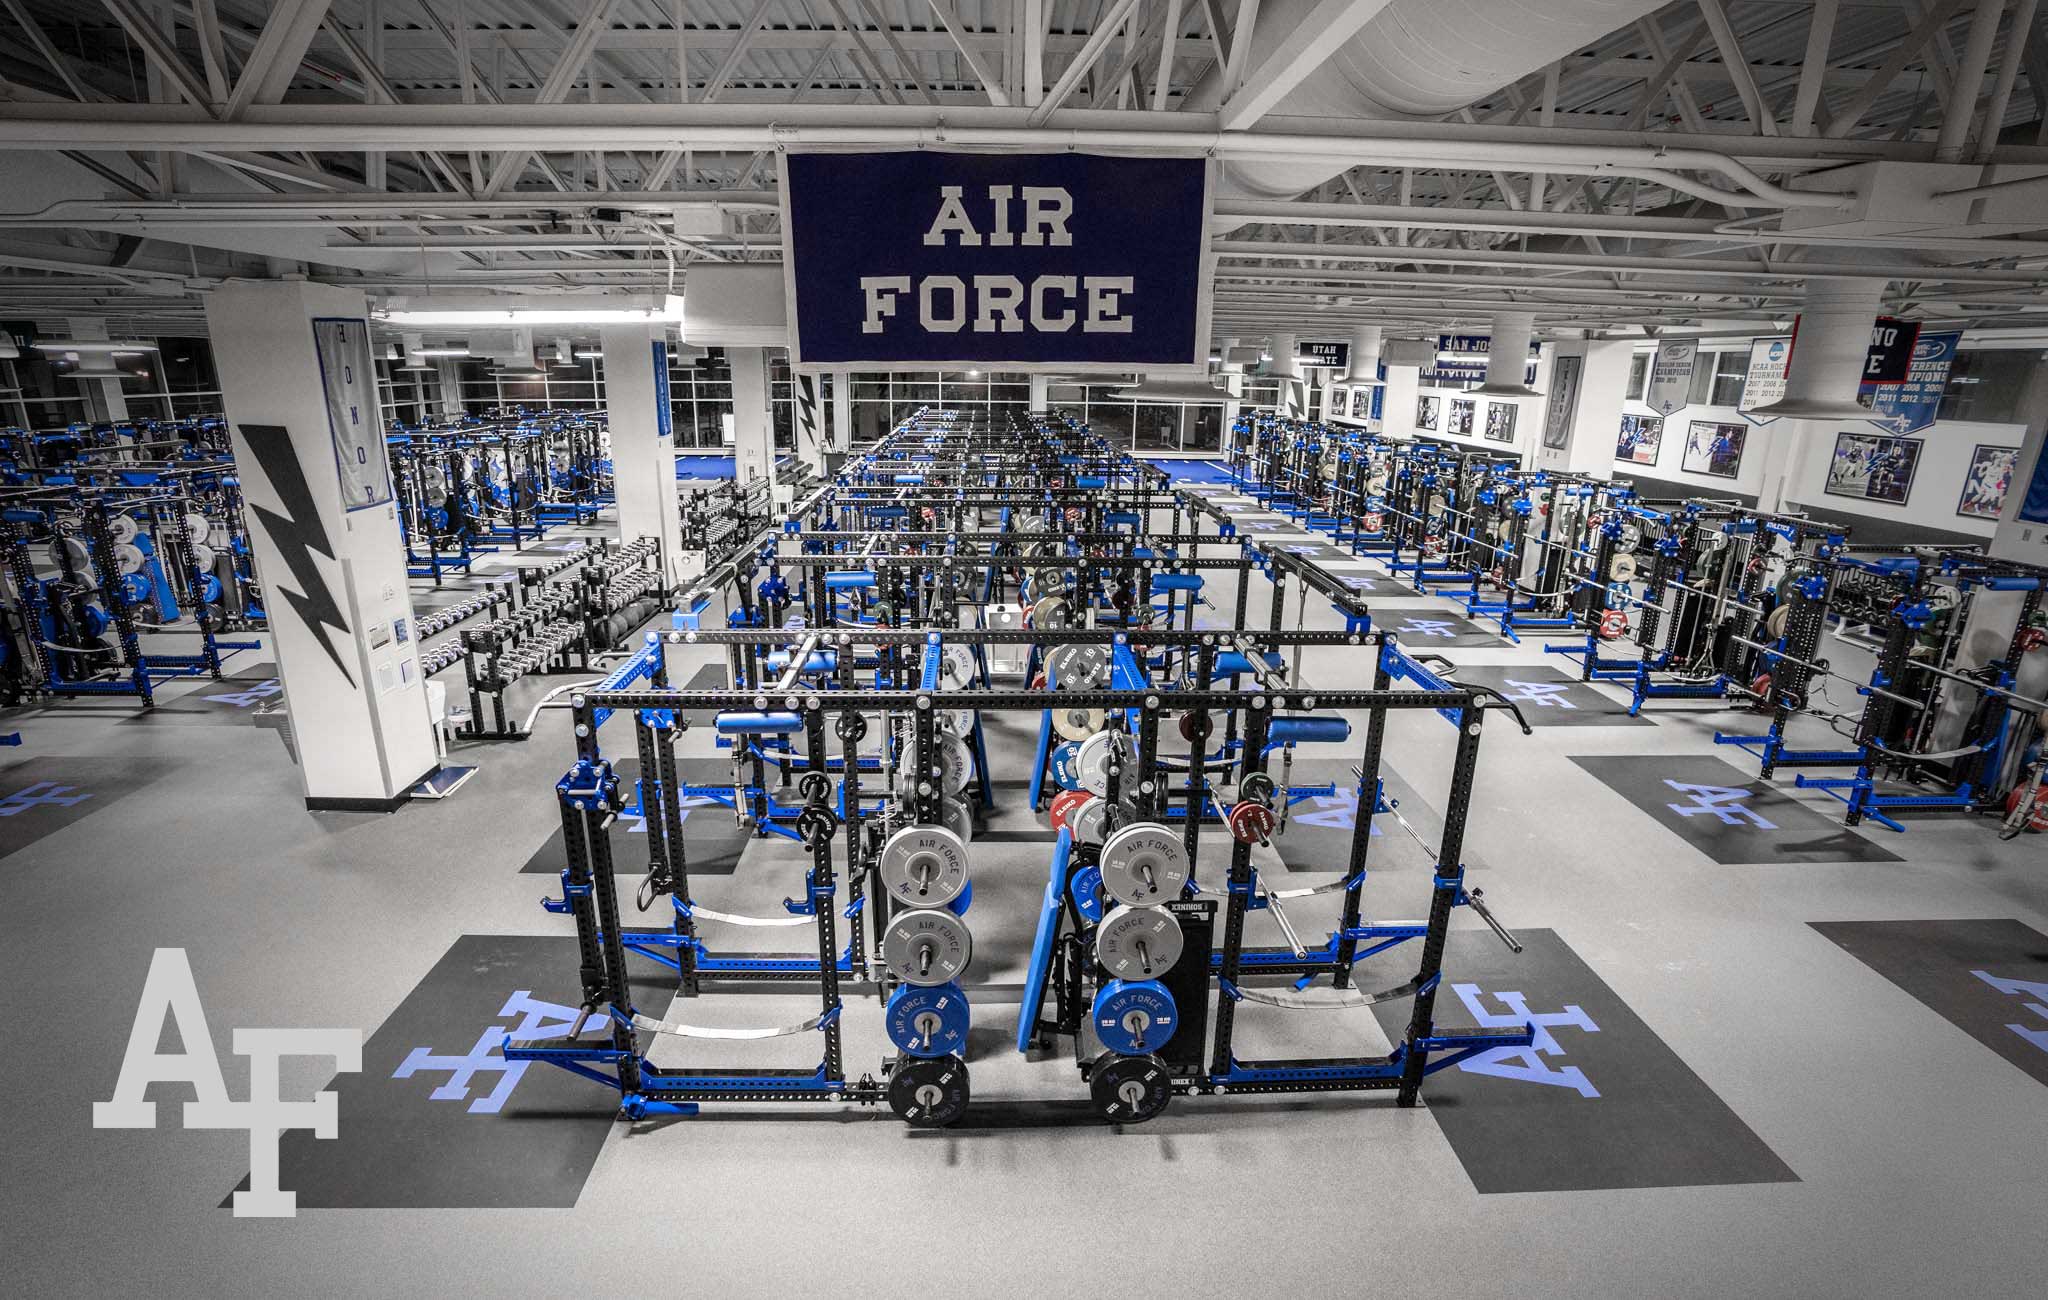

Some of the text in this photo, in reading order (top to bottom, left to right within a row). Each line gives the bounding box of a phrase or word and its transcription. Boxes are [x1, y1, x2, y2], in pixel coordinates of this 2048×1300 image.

[923, 185, 1073, 246] AIR
[860, 275, 1134, 334] FORCE
[1445, 340, 1469, 352] SAN
[1871, 327, 1898, 347] NO
[1312, 345, 1337, 354] UTAH
[1867, 354, 1885, 374] E
[1878, 393, 1897, 402] 2011
[1900, 394, 1919, 403] 2012
[1396, 617, 1458, 638] AF
[1059, 647, 1078, 670] ELEIKO
[1084, 647, 1097, 660] 10
[1083, 662, 1102, 684] ELEIKO
[1500, 679, 1577, 709] AF
[1056, 760, 1069, 783] ELEIKO
[1055, 799, 1077, 817] ELEIKO
[1663, 779, 1779, 830] AF
[919, 839, 960, 875] AIR FORCE
[1127, 839, 1179, 862] AIR FORCE
[1131, 888, 1145, 901] AF
[919, 921, 960, 953] AIR FORCE
[1108, 939, 1117, 953] AIR
[1113, 917, 1145, 937] FORCE
[898, 996, 928, 1017] FORCE
[1111, 995, 1163, 1011] AIR FORCE
[895, 1019, 906, 1034] AIR
[391, 990, 612, 1113] AF
[1449, 983, 1601, 1098] AF
